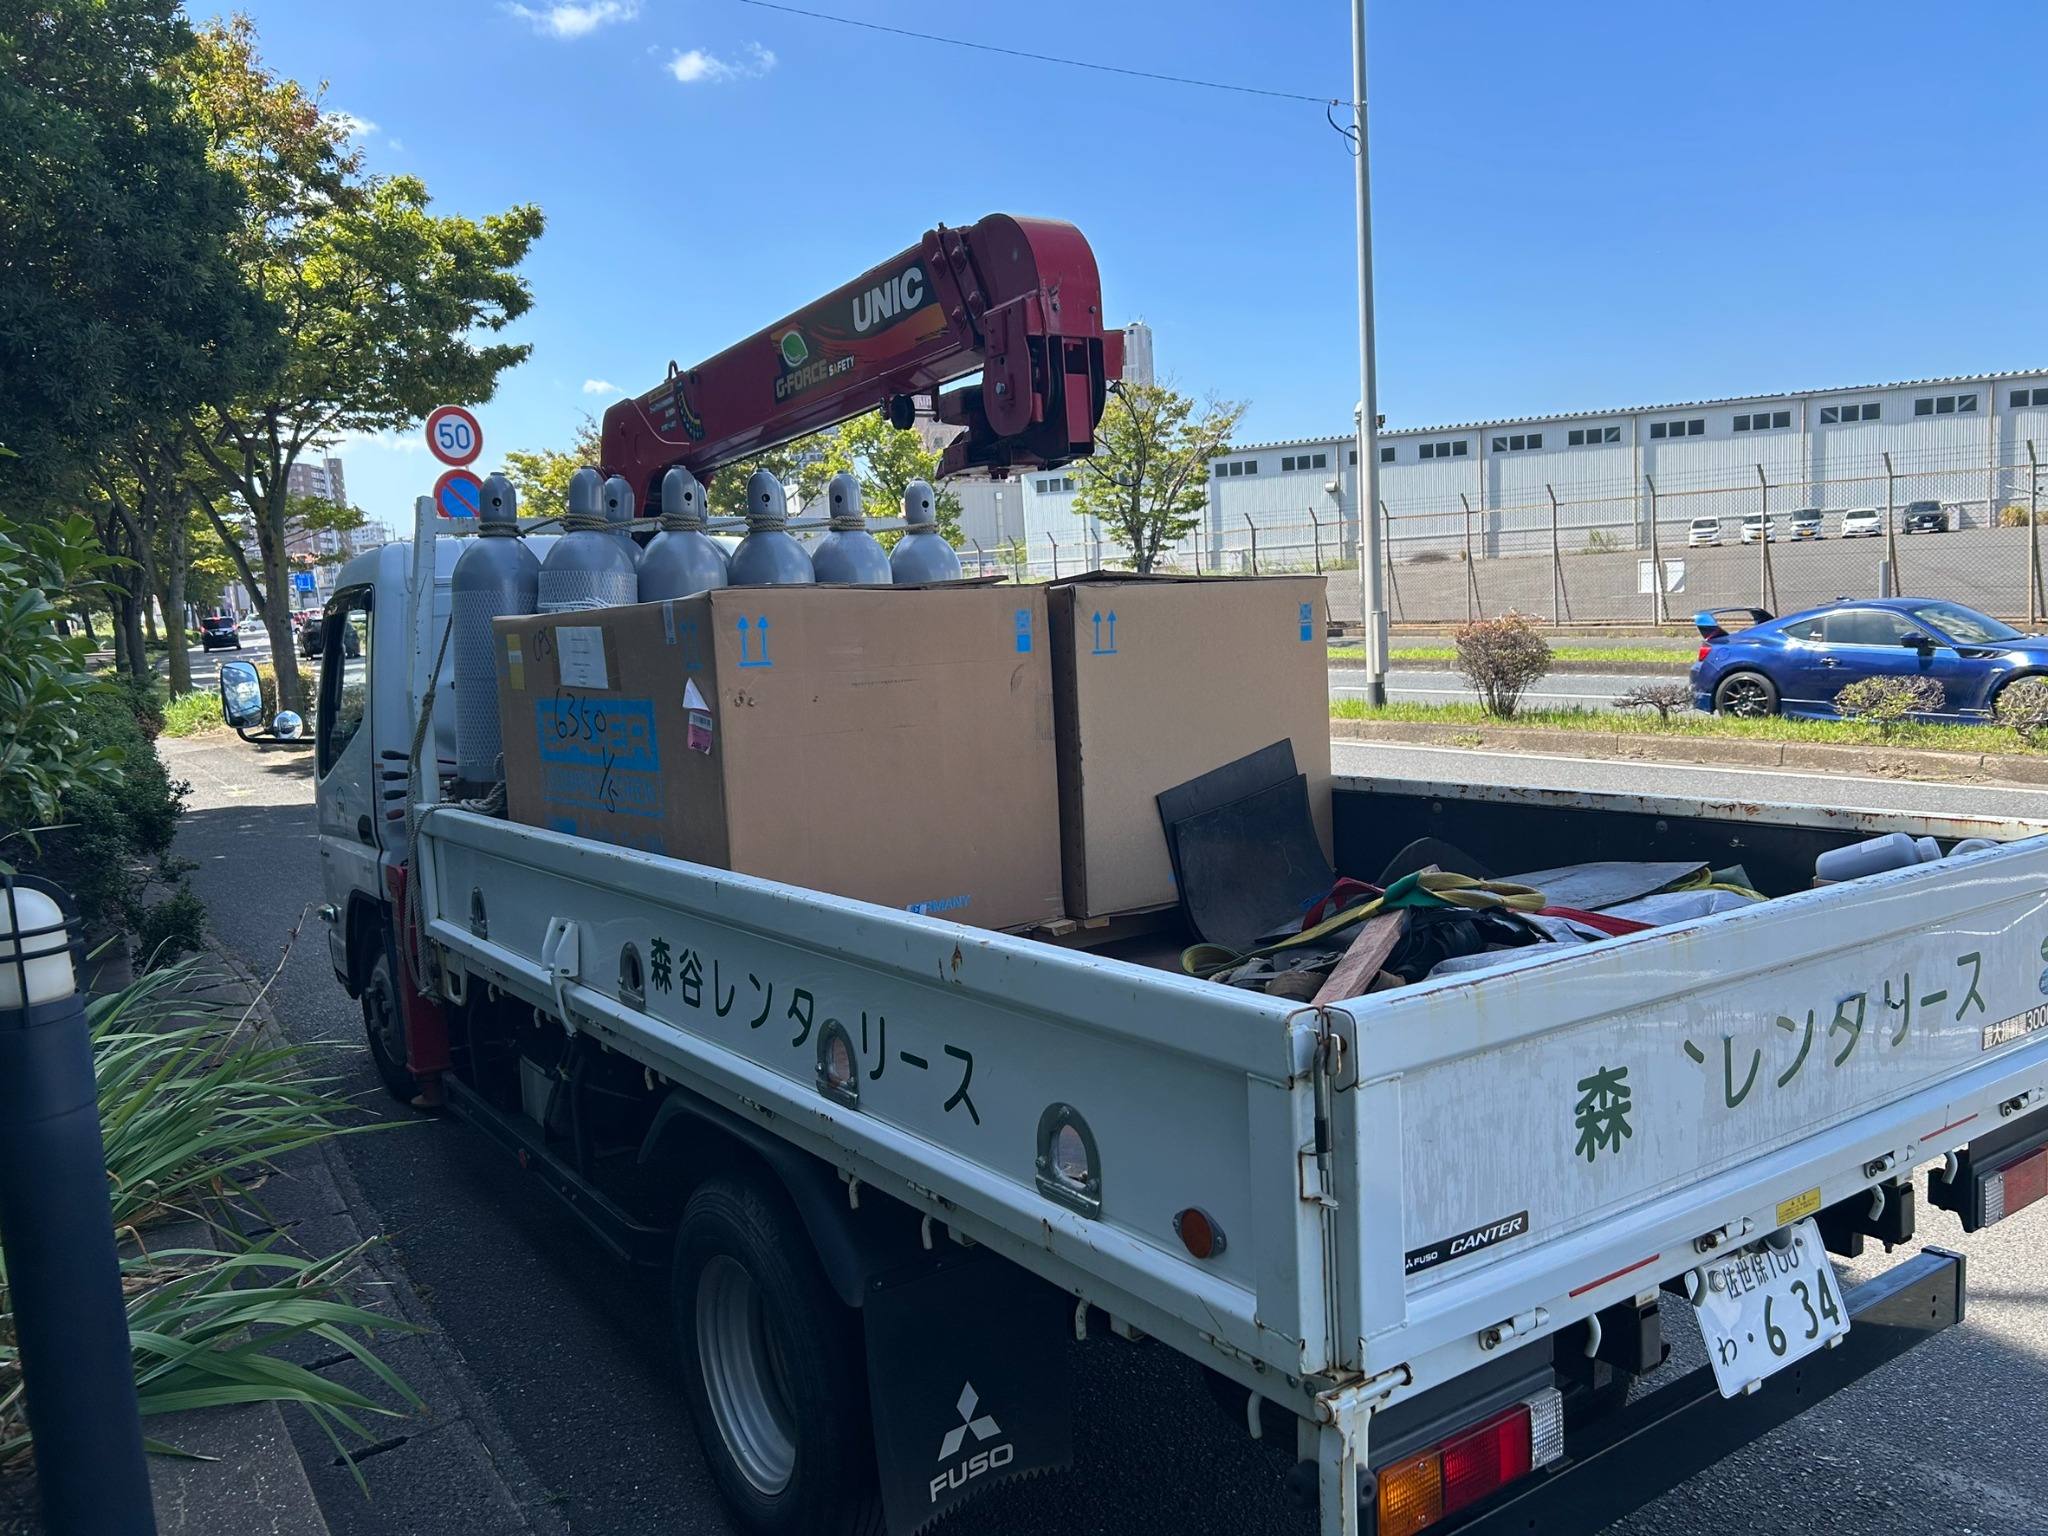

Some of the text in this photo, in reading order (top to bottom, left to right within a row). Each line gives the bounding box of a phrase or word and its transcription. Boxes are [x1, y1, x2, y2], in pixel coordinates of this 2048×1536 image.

[853, 267, 923, 332] UNIC
[829, 356, 854, 376] SAFETY
[438, 423, 470, 449] 50
[542, 712, 651, 761] BAUER
[555, 688, 606, 740] 6350
[1413, 1217, 1523, 1266] FUSO CANTER
[929, 1443, 1014, 1503] FUSO
